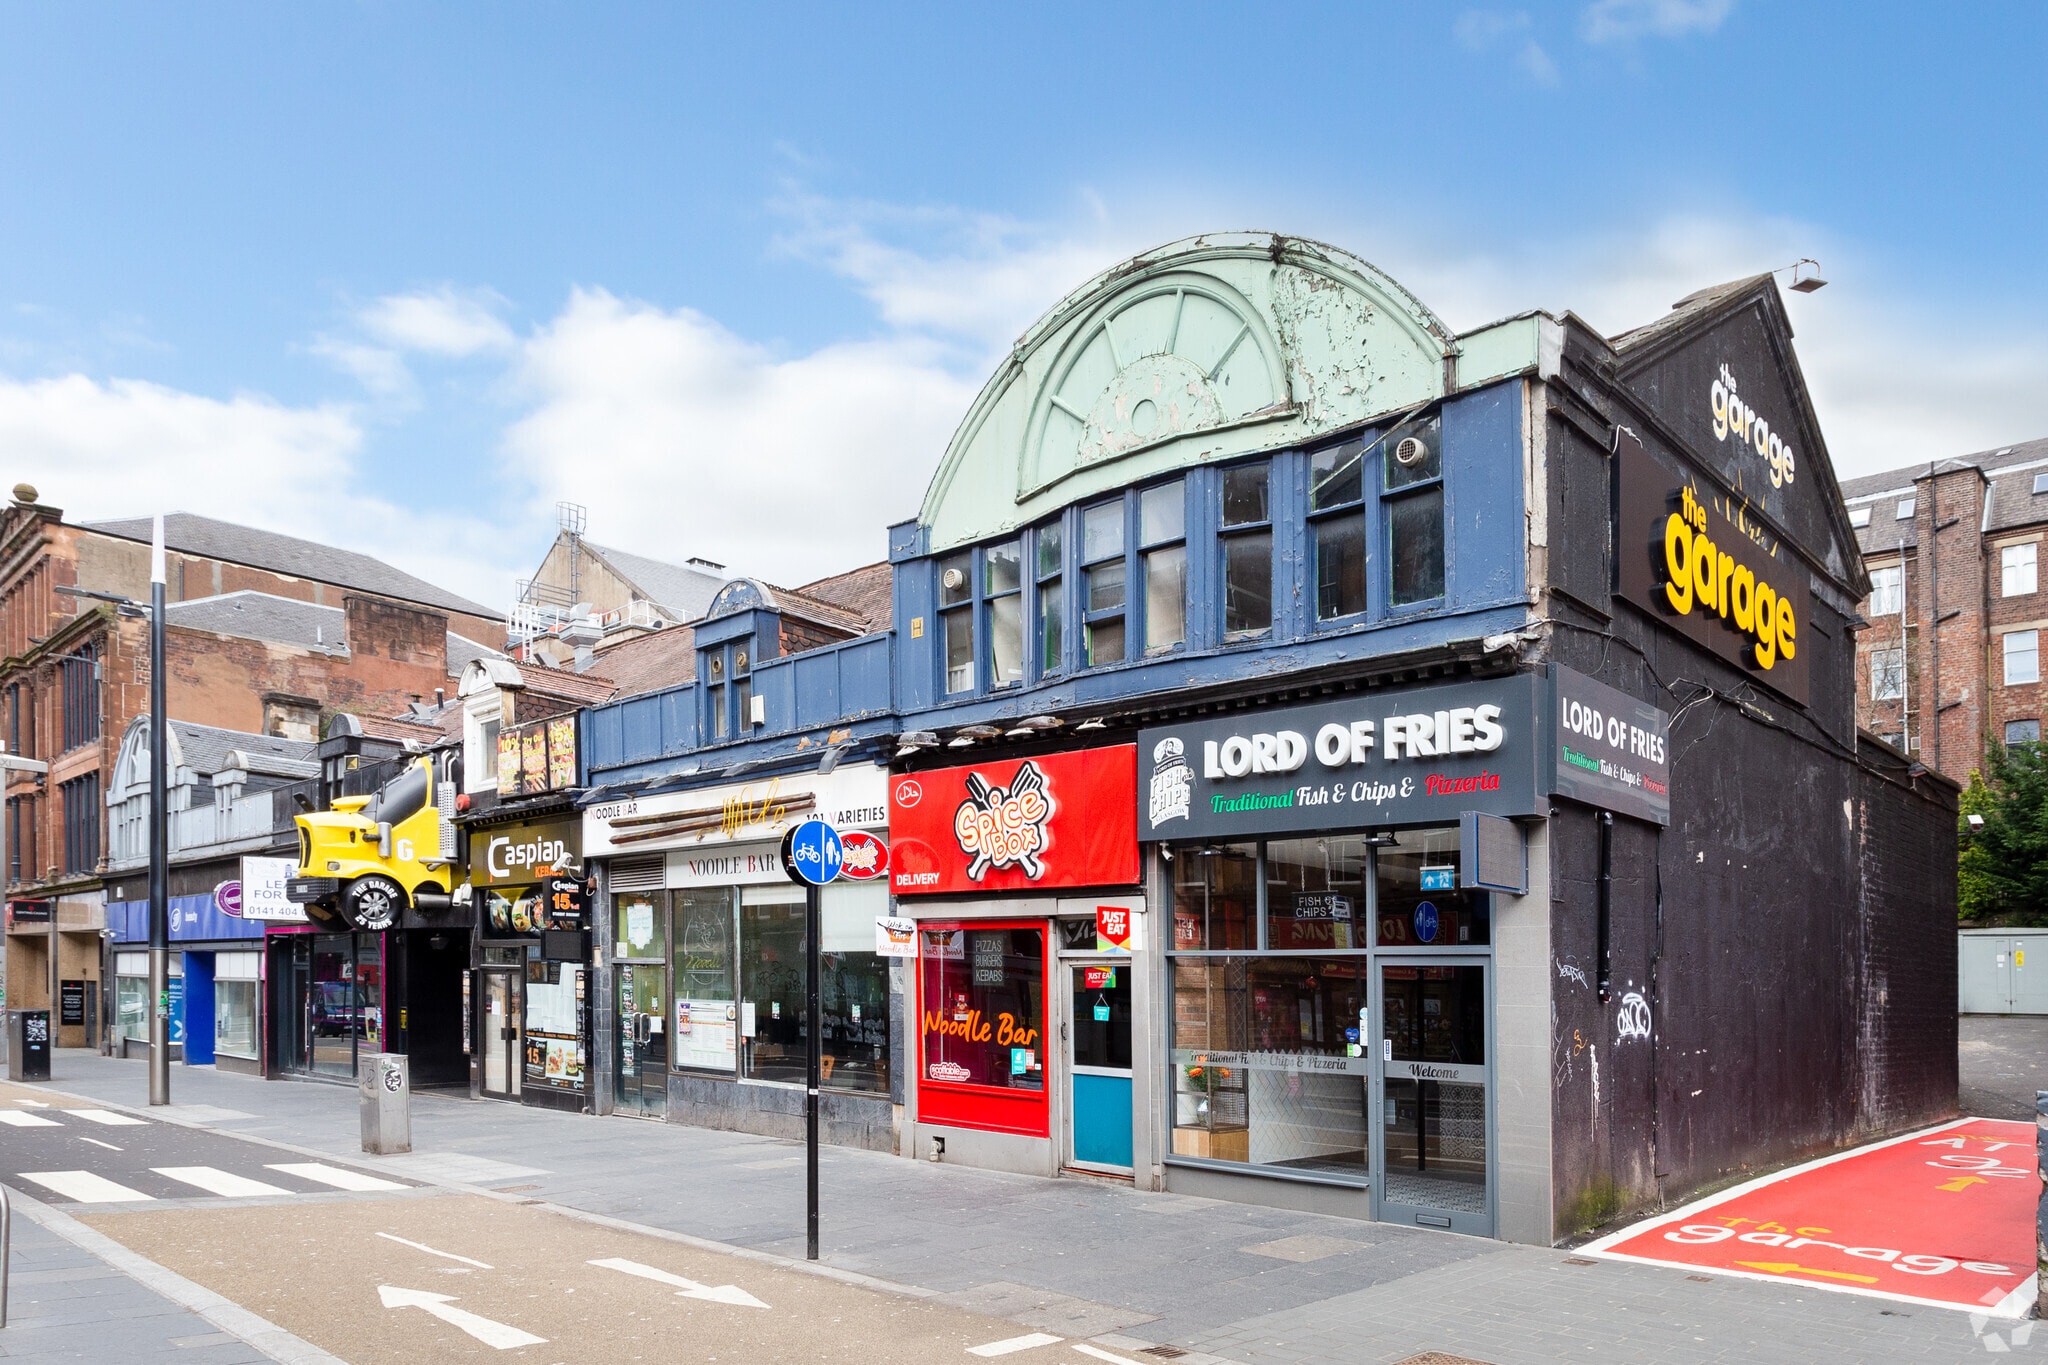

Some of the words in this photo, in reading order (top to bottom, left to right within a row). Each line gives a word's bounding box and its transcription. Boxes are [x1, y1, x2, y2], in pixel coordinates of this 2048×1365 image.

[1720, 363, 1737, 393] the
[1711, 380, 1795, 489] garage
[1682, 486, 1707, 533] the
[1665, 513, 1796, 670] garage
[1563, 697, 1603, 740] LORD
[1607, 717, 1627, 750] OF
[1630, 725, 1664, 765] FRIES
[1204, 729, 1307, 779] LORD
[1314, 719, 1375, 768] OF
[1383, 703, 1504, 760] FRIES
[1563, 745, 1599, 772] Traditional
[1600, 759, 1613, 777] Fish
[1613, 764, 1620, 778] &
[1620, 766, 1636, 787] Chips
[1636, 772, 1642, 786] &
[1151, 768, 1183, 799] FISH
[1210, 789, 1293, 814] Traditional
[1296, 785, 1329, 807] Fish
[1332, 783, 1347, 803] &
[1351, 780, 1396, 806] Chips
[1400, 777, 1415, 798] &
[1424, 770, 1500, 796] Pizzeria
[899, 786, 919, 801] حلال
[1151, 785, 1190, 819] CHIPS
[590, 805, 620, 819] NOODLE
[622, 803, 638, 815] BAR
[829, 806, 885, 825] VARIETIES
[1156, 808, 1185, 821] GLASGOW
[957, 792, 1044, 855] Spice
[397, 838, 414, 861] G
[990, 828, 1036, 861] Box
[488, 836, 565, 877] Caspian
[688, 856, 741, 877] NOODLE
[748, 853, 775, 873] BAR
[896, 873, 940, 886] DELIVERY
[254, 890, 282, 899] FOR
[352, 883, 368, 898] THE
[369, 881, 398, 899] GARAGE
[552, 893, 571, 910] 15
[1298, 896, 1321, 906] FISH
[249, 906, 274, 915] 0141
[278, 907, 298, 916] 404
[1102, 911, 1125, 924] JUST
[1295, 907, 1327, 918] CHIPS
[354, 914, 367, 926] 25
[368, 918, 392, 930] YEARS
[1107, 924, 1126, 935] EAT
[975, 940, 1002, 953] PIZZAS
[975, 954, 1003, 967] BURGERS
[975, 969, 1003, 982] KEBABS
[1088, 972, 1101, 981] JUST
[924, 1010, 992, 1043] Noodle
[997, 1012, 1038, 1046] Bar
[1269, 1054, 1294, 1069] Chips
[1296, 1056, 1304, 1068] &
[1307, 1056, 1347, 1070] Pizzeria
[1408, 1063, 1459, 1079] Welcome
[1716, 1215, 1833, 1237] the
[1664, 1224, 2017, 1277] garage
